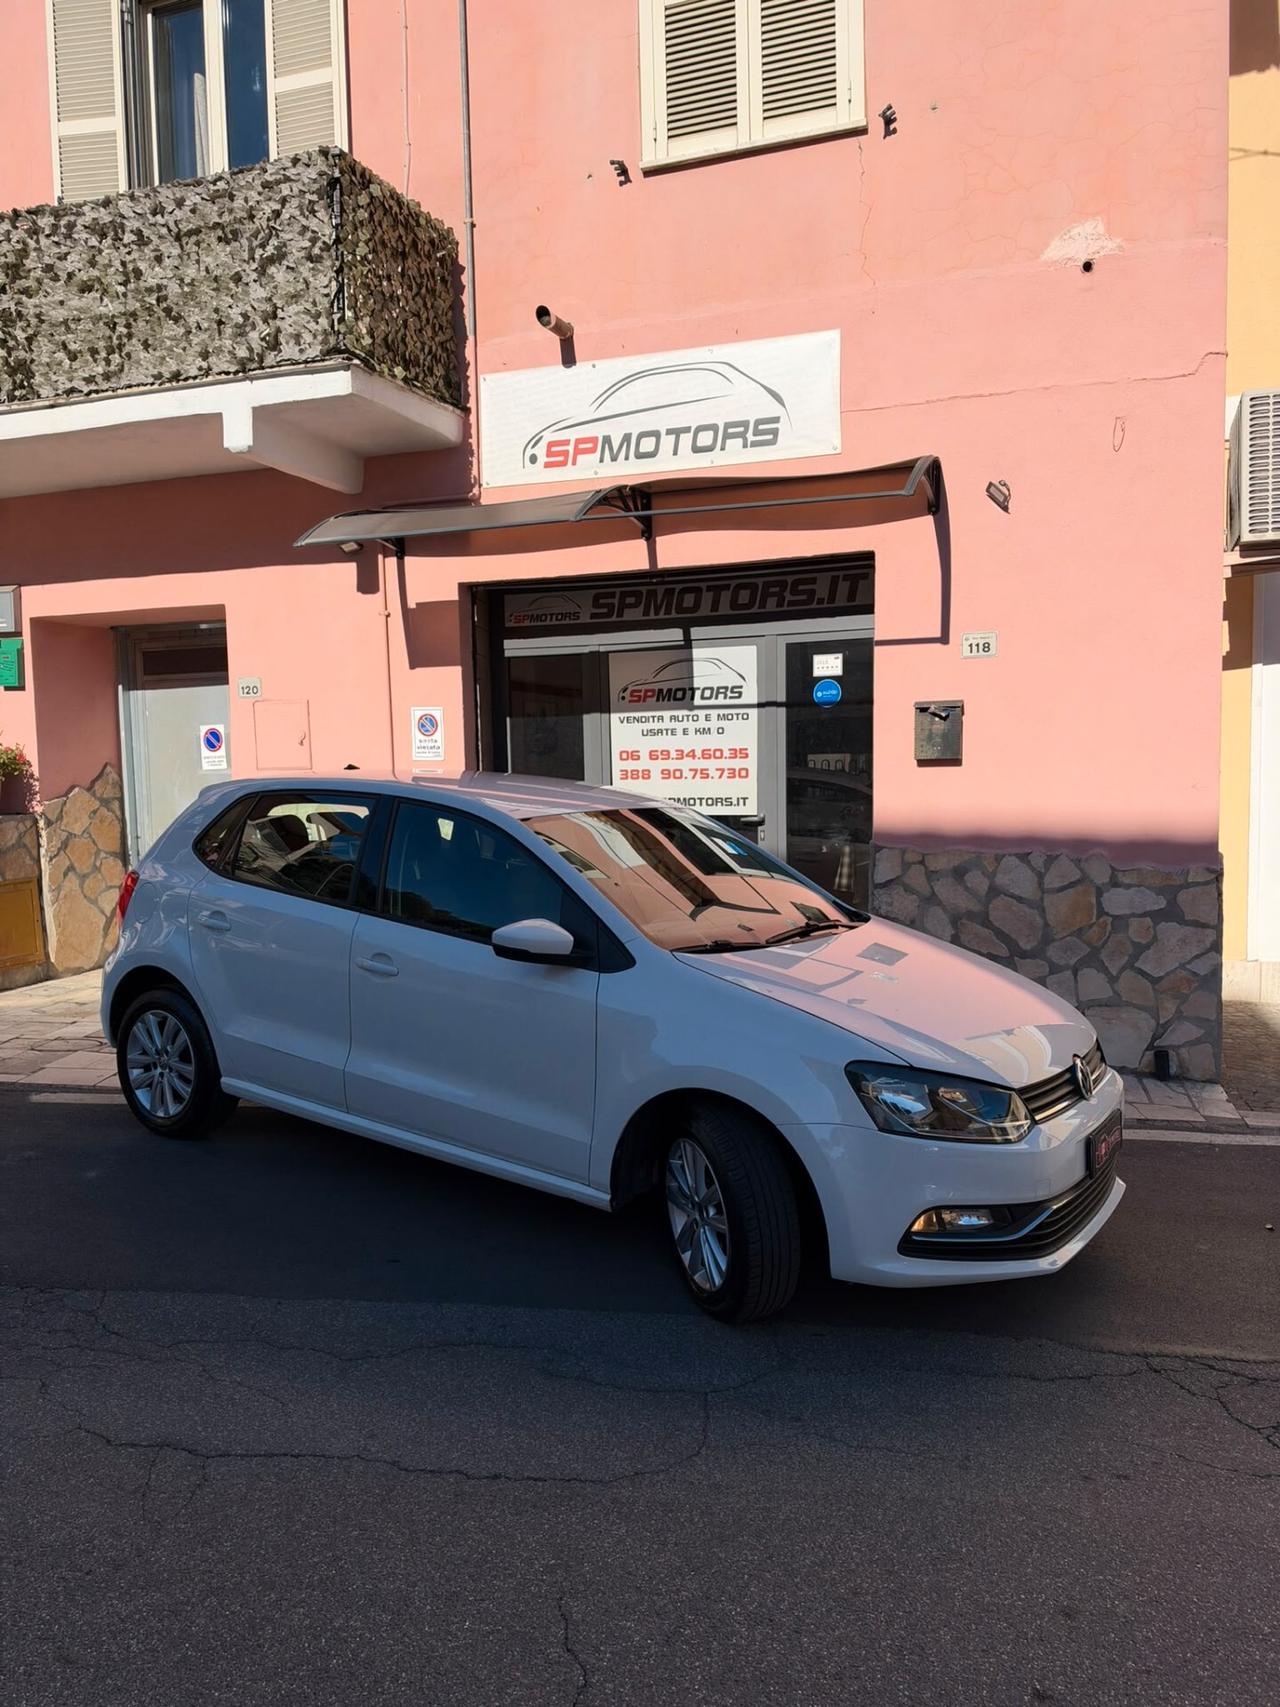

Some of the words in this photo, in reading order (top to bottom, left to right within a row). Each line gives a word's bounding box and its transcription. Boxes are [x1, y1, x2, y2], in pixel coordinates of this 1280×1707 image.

[543, 416, 781, 469] SPMOTORS
[590, 572, 869, 620] SPMOTORS.IT
[513, 611, 581, 624] SPMOTORS
[968, 642, 991, 654] 118
[241, 685, 259, 695] 120
[628, 685, 743, 704] SPMOTORS
[618, 715, 664, 724] VENDITA
[669, 714, 700, 723] AUTO
[705, 713, 712, 722] E
[717, 712, 750, 722] MOTO
[641, 728, 677, 737] USATE
[682, 727, 689, 736] E
[694, 727, 711, 736] KM
[619, 750, 641, 761] 06
[648, 748, 750, 761] 69.34.60.35
[619, 769, 651, 780] 388
[660, 767, 749, 780] 90.75.730
[664, 797, 749, 807] MOTORS.IT
